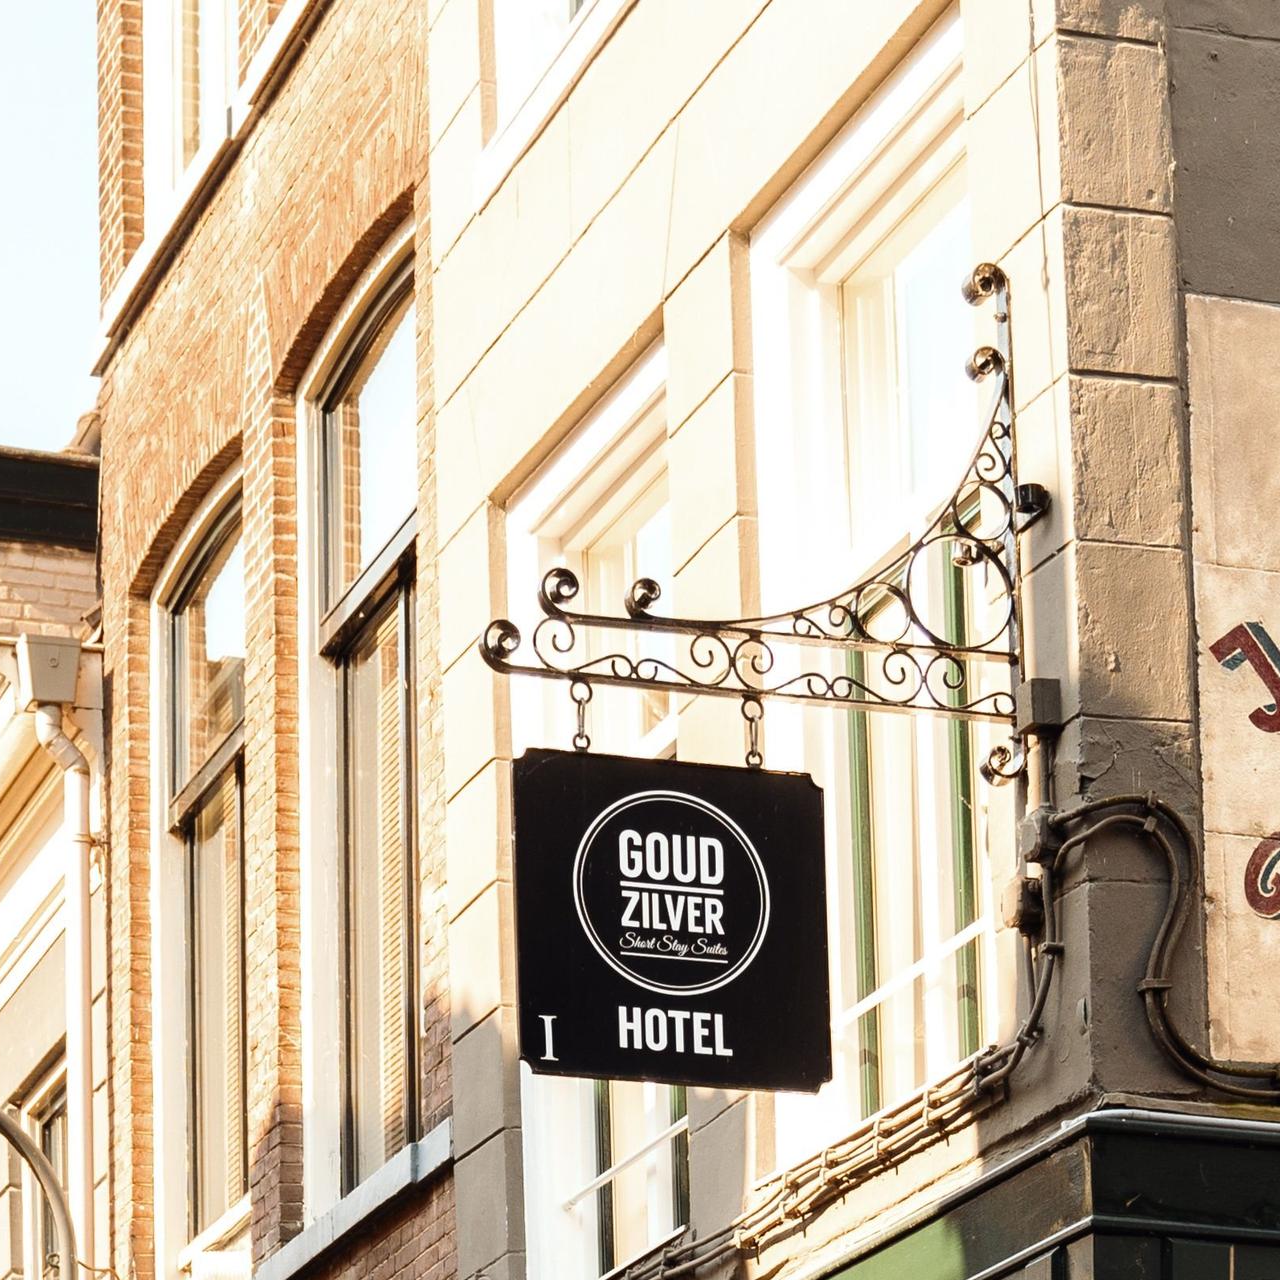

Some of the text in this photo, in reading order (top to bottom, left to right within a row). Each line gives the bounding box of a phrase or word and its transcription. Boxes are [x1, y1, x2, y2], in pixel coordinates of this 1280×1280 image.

[618, 829, 725, 886] GOUD
[620, 890, 726, 936] ZILVER
[619, 931, 729, 957] Short Stay Suites
[538, 1014, 559, 1062] I
[618, 1005, 734, 1057] HOTEL
